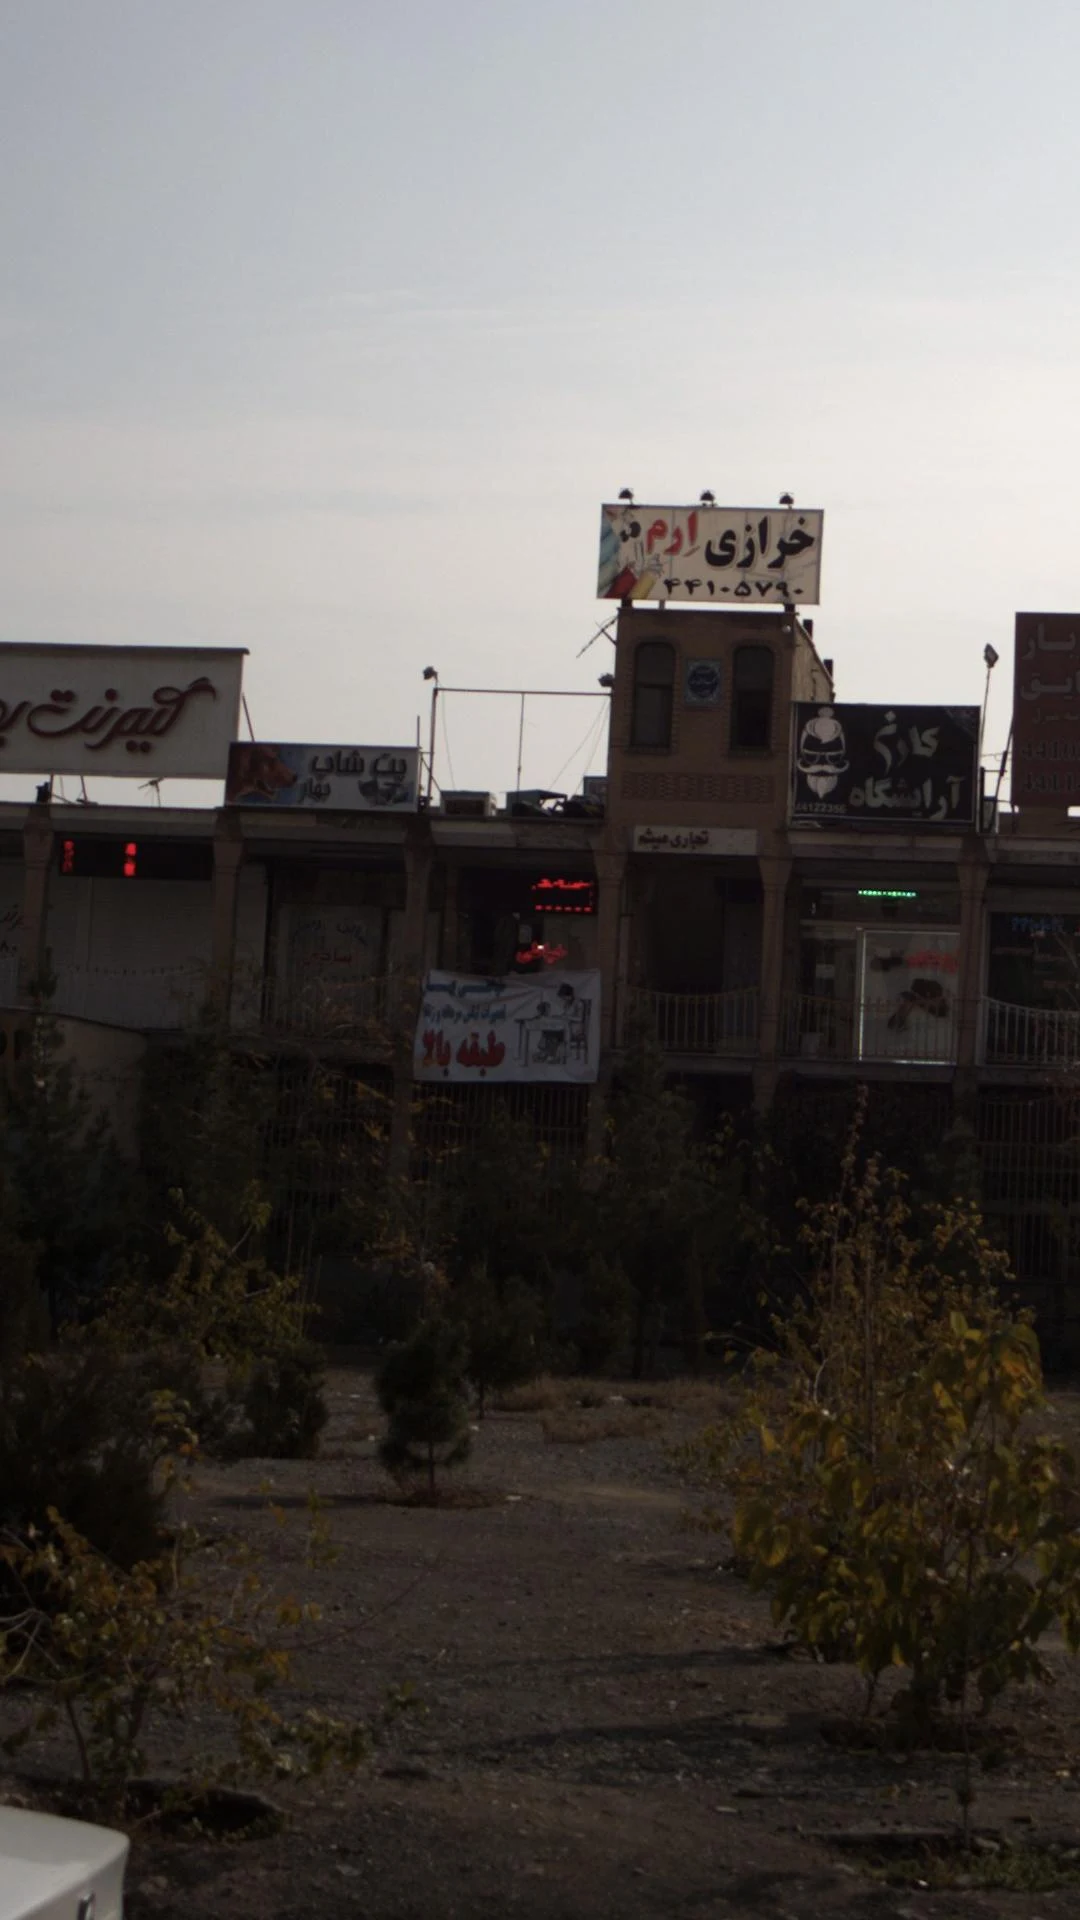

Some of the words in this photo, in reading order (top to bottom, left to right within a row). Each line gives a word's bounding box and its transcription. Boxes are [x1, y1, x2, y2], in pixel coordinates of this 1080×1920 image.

[706, 515, 815, 569] خرازی
[310, 750, 365, 781] شاپ
[849, 775, 966, 821] آرایشگاه
[456, 1030, 506, 1077] طبقه
